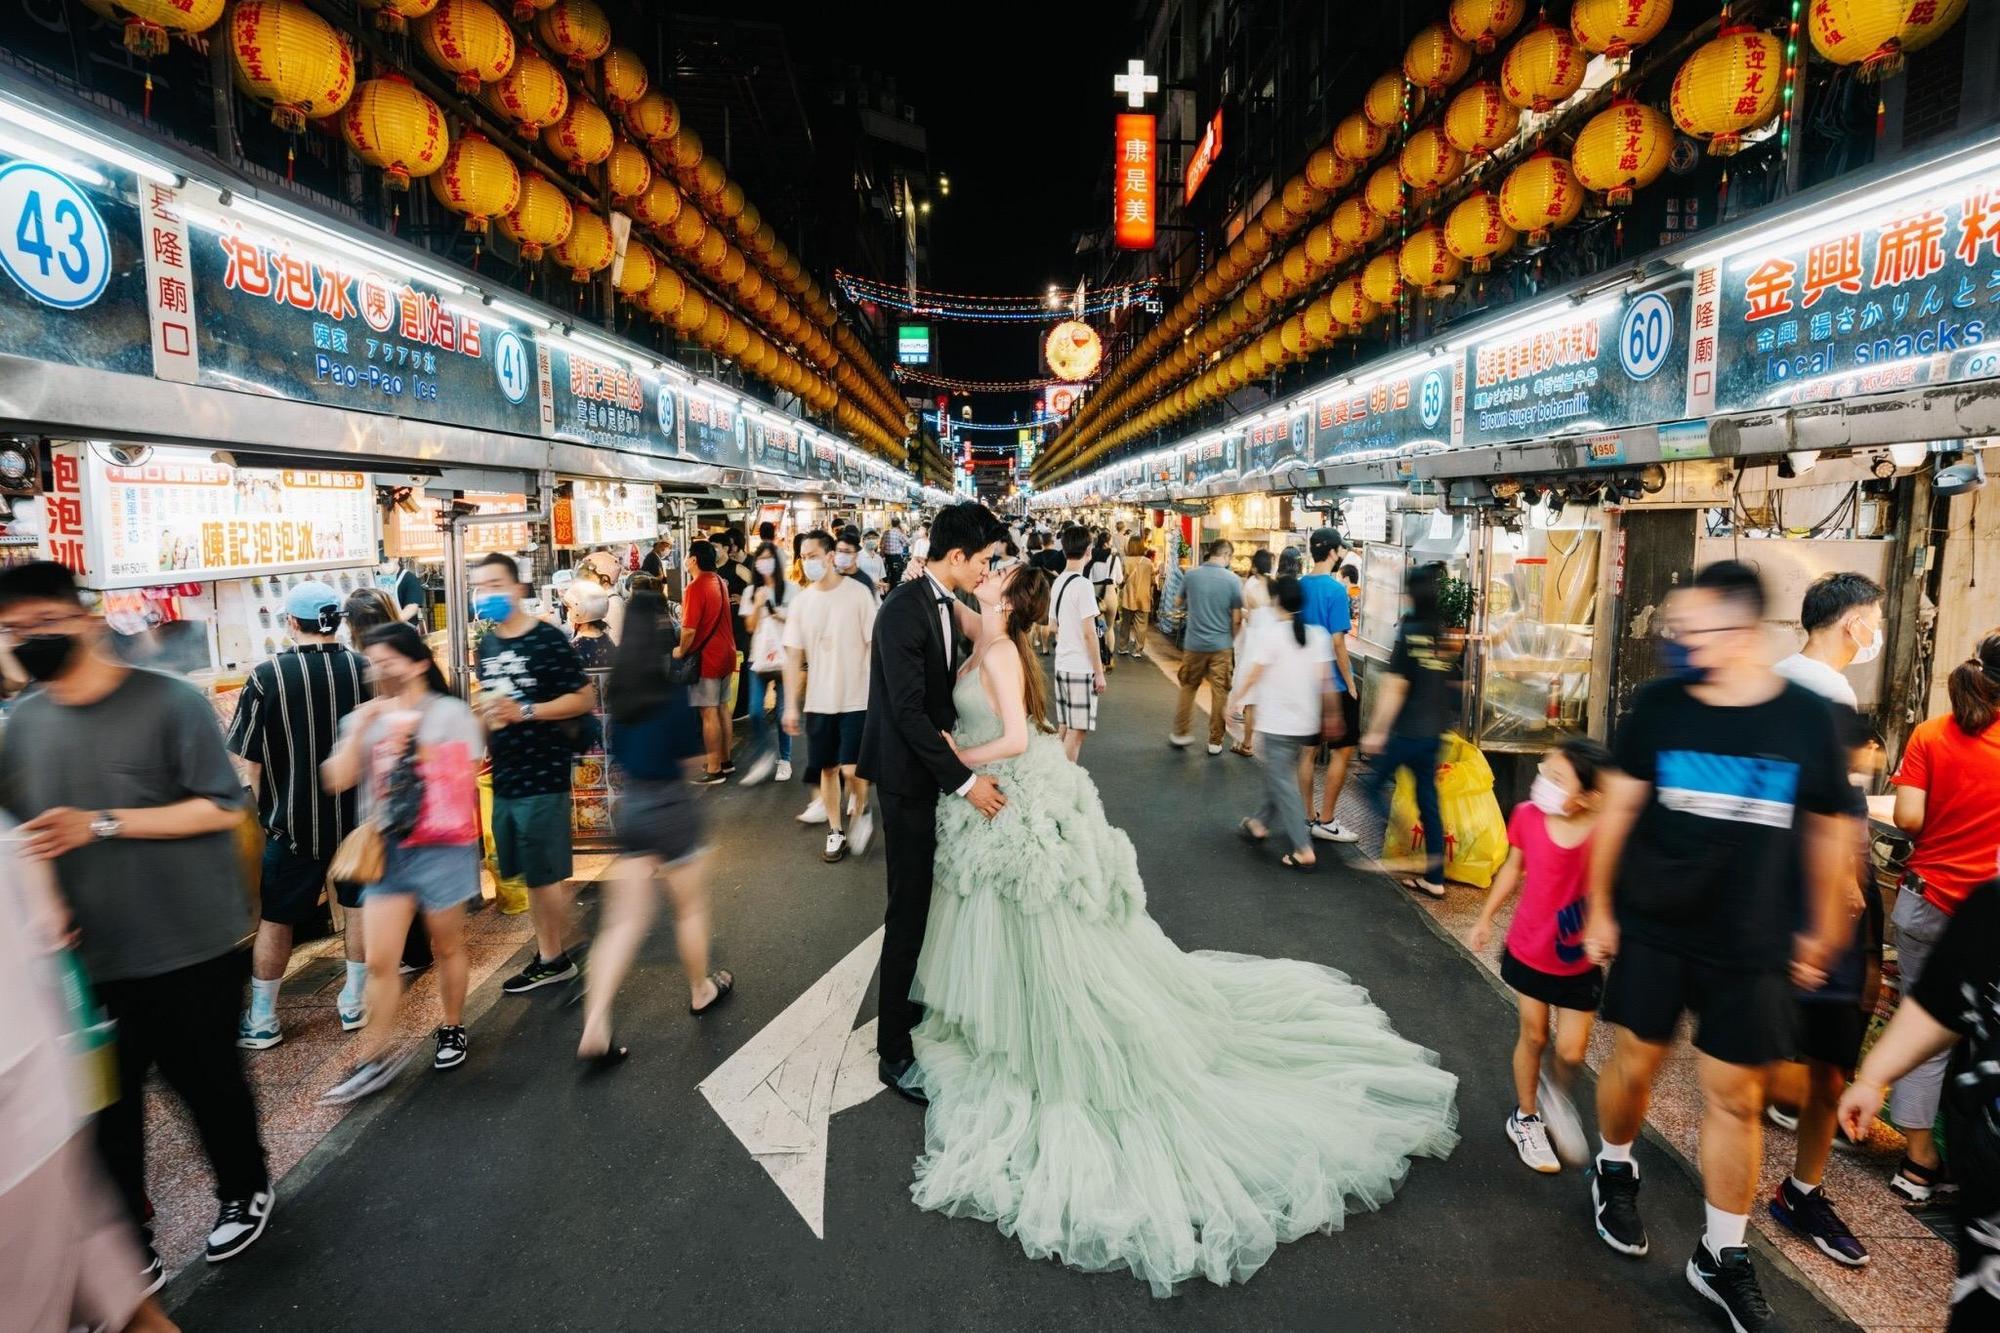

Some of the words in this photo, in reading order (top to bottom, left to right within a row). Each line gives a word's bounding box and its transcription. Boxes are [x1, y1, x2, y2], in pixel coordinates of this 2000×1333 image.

[236, 2, 272, 82] 開漳聖王
[1733, 36, 1767, 115] 歡迎光臨
[1619, 107, 1643, 170] 歡迎光臨
[1125, 138, 1148, 223] 康是美
[16, 190, 91, 285] 43
[149, 183, 191, 356] 基隆廟口
[218, 233, 357, 321] 泡泡冰
[365, 282, 389, 322] 陳
[398, 287, 482, 358] 創始店
[313, 322, 348, 353] 陳家
[1629, 307, 1663, 366] 60
[1693, 266, 1717, 396] 基隆廟口
[1757, 321, 1798, 353] 金興
[1766, 343, 1835, 382] local
[1854, 319, 1985, 366] snacks
[316, 354, 404, 395] Pao-Pao
[413, 374, 437, 400] Ice
[502, 344, 523, 391] 41
[660, 394, 671, 426] 39
[1319, 376, 1410, 430] 營養三明治
[1424, 381, 1440, 418] 58
[1480, 411, 1508, 430] Brown
[1508, 403, 1539, 429] suger
[1537, 391, 1590, 422] bobamilk
[1593, 443, 1616, 457] 1950
[202, 520, 316, 568] 陳記泡泡冰
